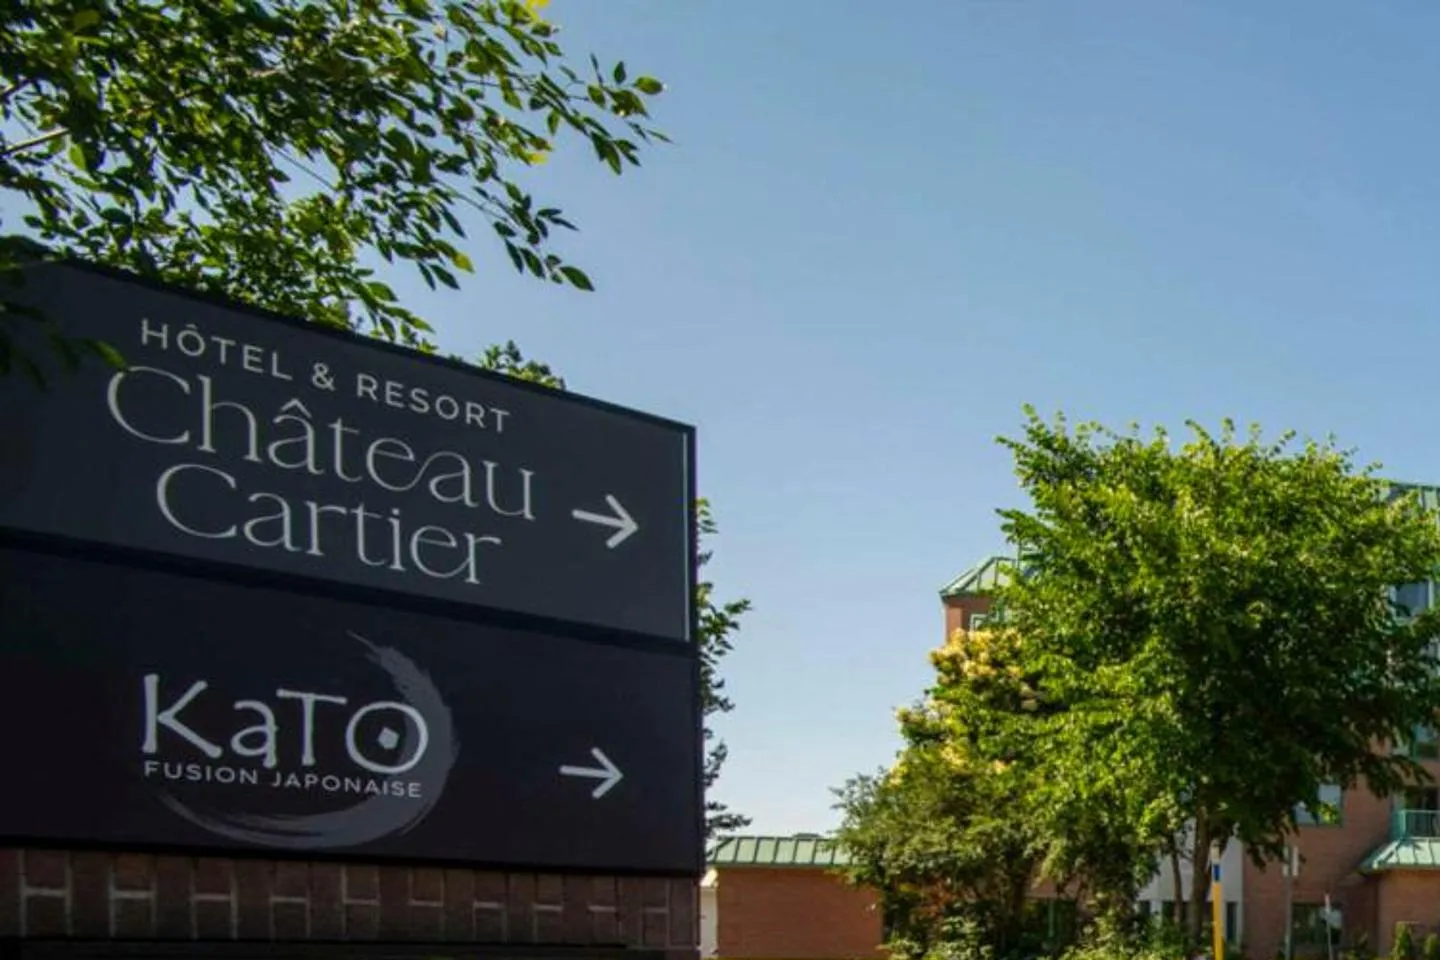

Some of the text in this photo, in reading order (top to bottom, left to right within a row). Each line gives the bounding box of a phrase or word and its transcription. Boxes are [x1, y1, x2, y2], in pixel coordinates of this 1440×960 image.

[140, 318, 511, 433] HÔTEL & RESORT
[106, 365, 536, 521] Château
[155, 463, 502, 585] Cartier
[144, 759, 423, 798] FUSION JAPONAISE
